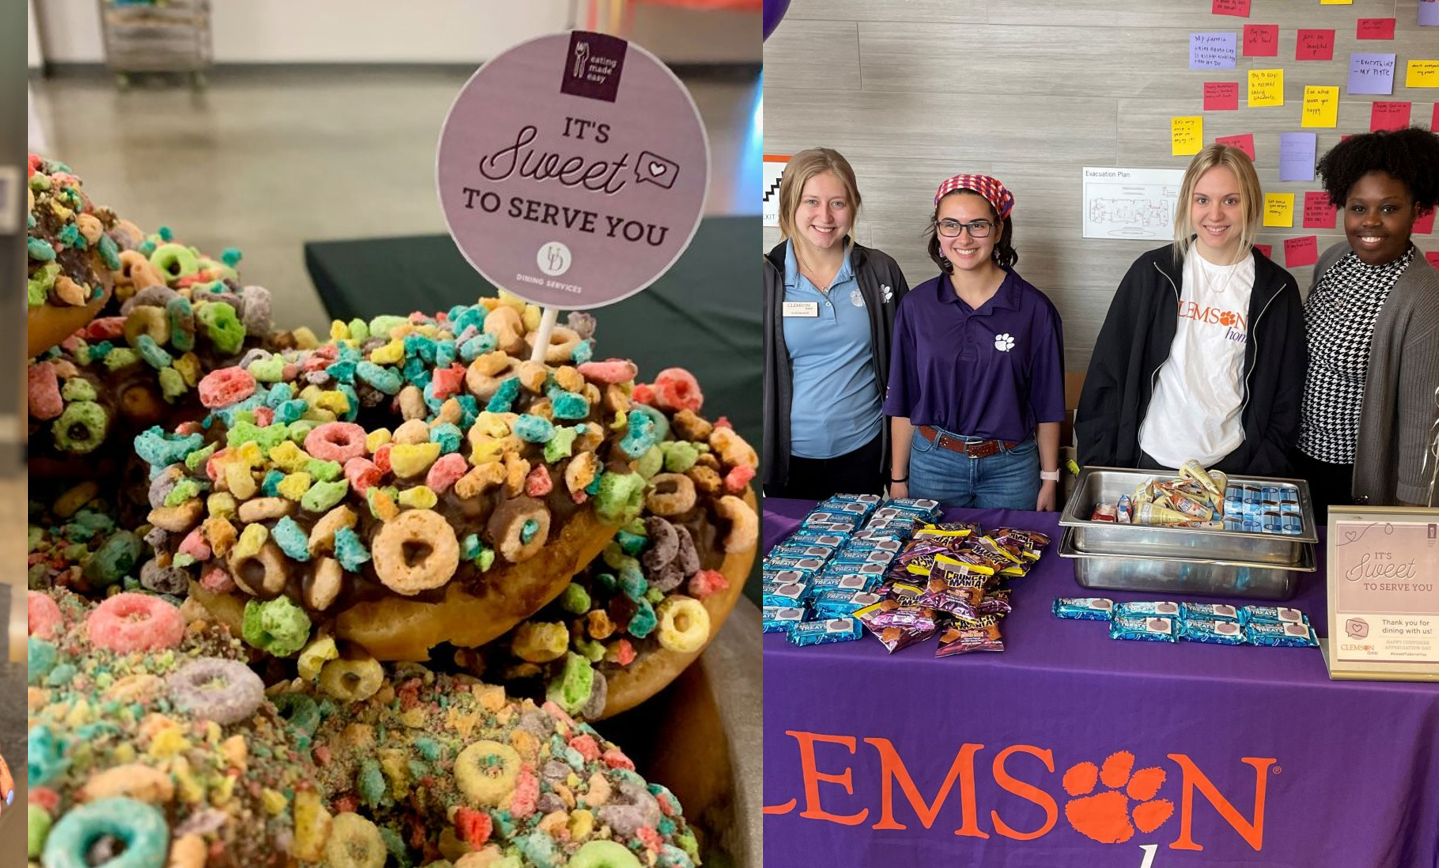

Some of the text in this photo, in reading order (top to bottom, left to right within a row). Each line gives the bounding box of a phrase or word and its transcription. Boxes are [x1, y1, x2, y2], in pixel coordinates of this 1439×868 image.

[590, 56, 618, 69] eating
[588, 64, 613, 75] made
[586, 73, 606, 84] easy
[562, 116, 611, 144] IT'S
[479, 125, 629, 195] Sweet
[1085, 170, 1116, 178] Evacuation
[462, 187, 670, 247] TO SERVE YOU
[516, 273, 583, 294] DINING SERVICES
[1375, 552, 1392, 560] IT'S
[1346, 552, 1417, 583] Sweet
[945, 570, 987, 583] CRUNCH
[948, 579, 984, 589] MANIA
[1364, 582, 1433, 592] TO SERVE YOU
[1382, 627, 1404, 635] dining
